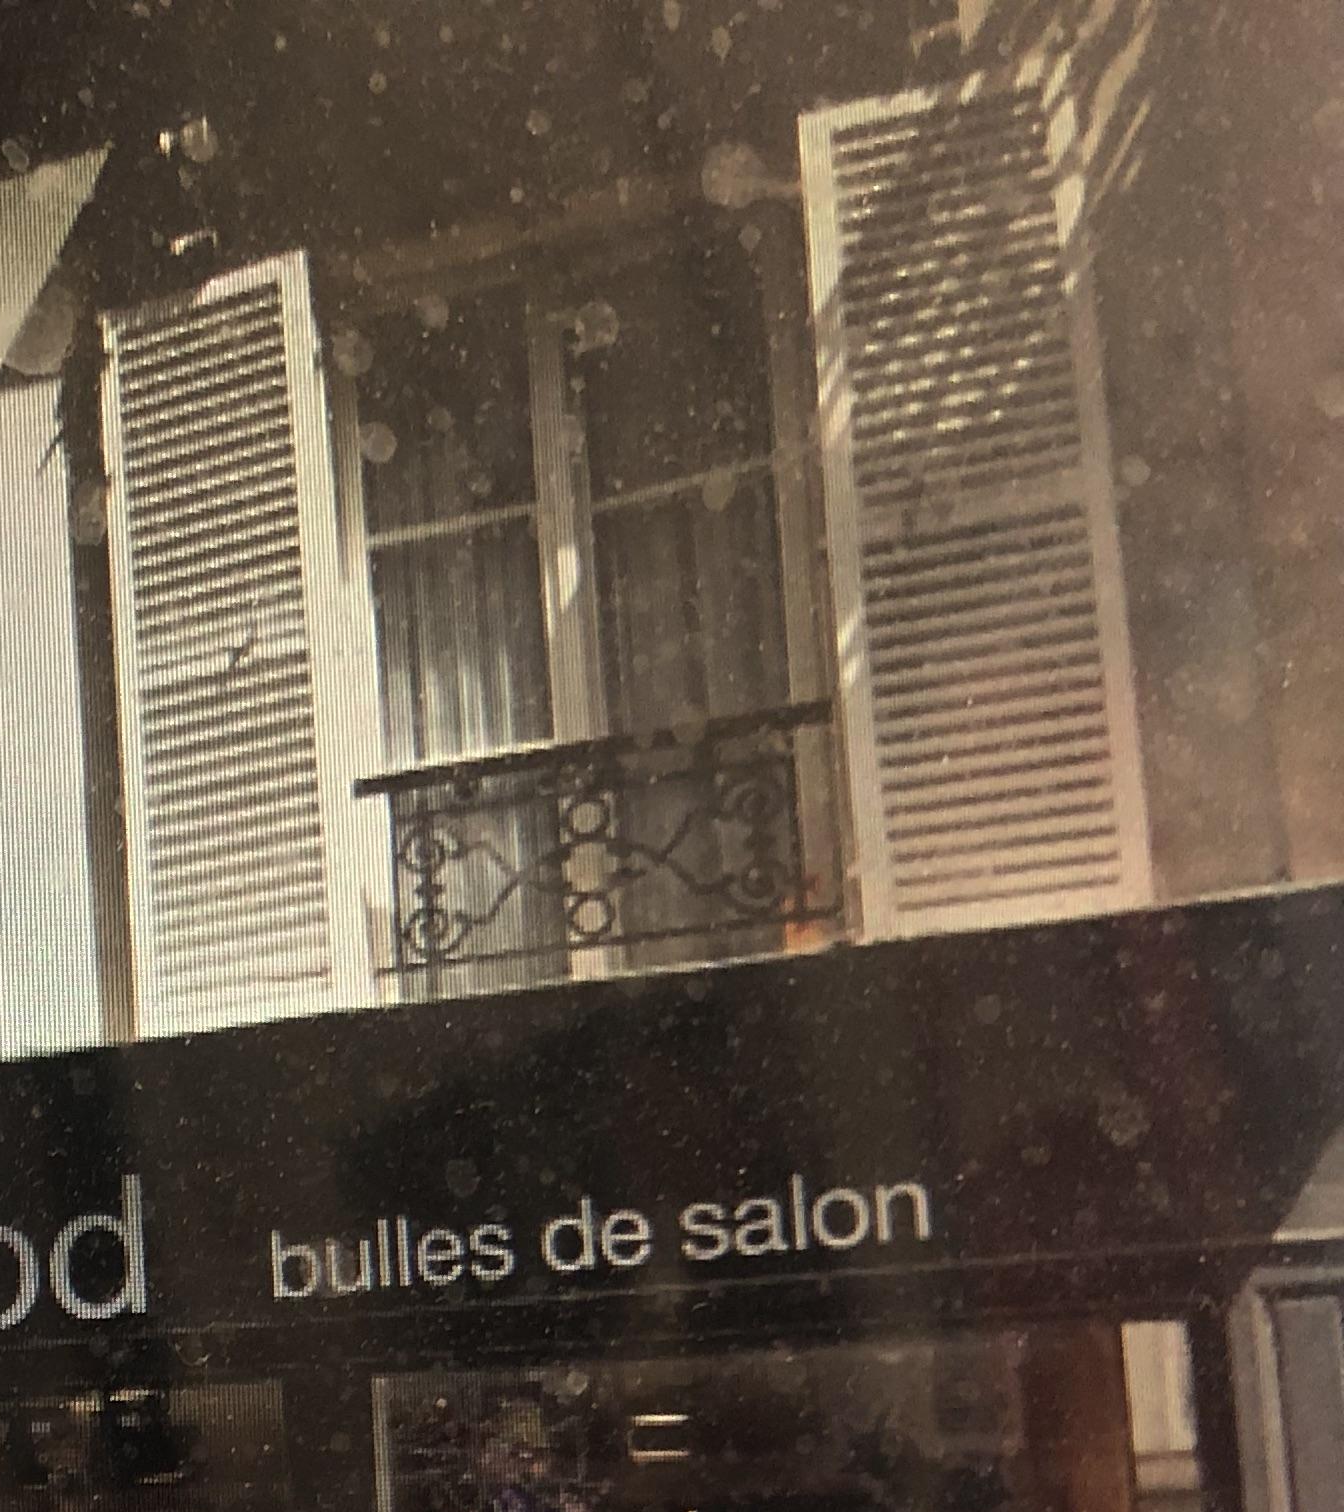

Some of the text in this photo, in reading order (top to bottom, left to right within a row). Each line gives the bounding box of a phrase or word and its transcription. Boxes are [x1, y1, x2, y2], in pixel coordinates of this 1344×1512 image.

[270, 1173, 934, 1301] bulles de salon
